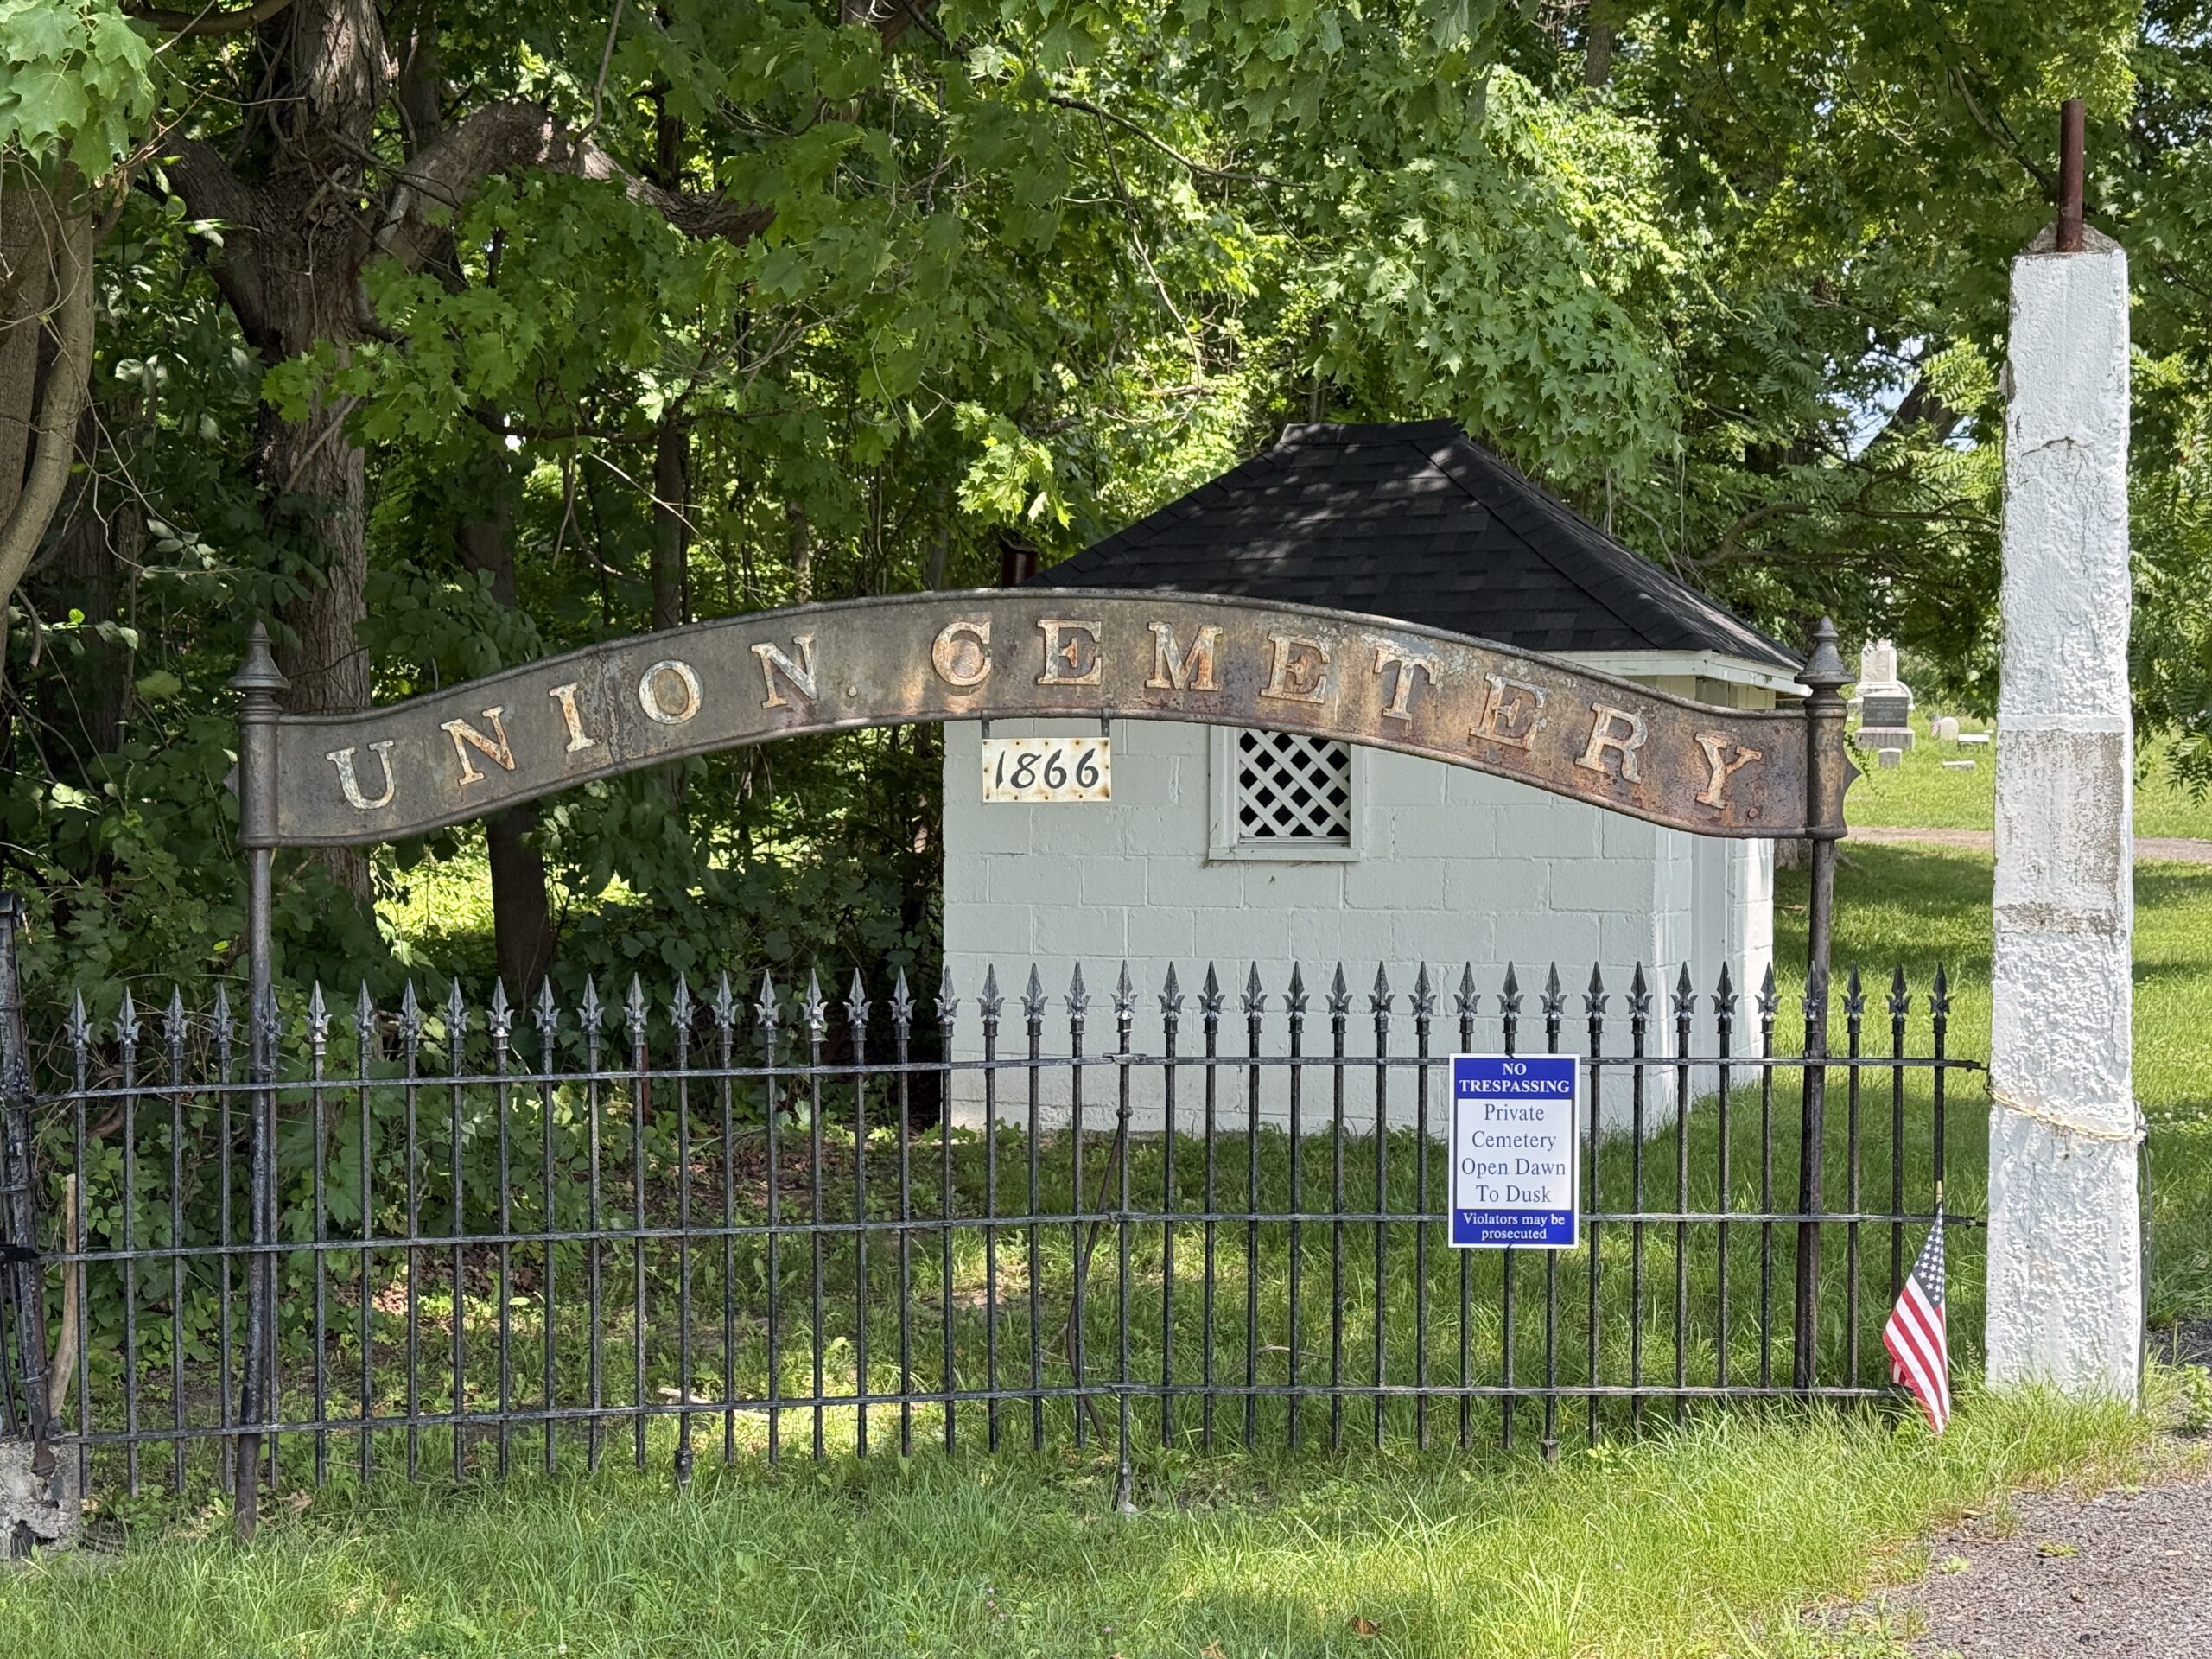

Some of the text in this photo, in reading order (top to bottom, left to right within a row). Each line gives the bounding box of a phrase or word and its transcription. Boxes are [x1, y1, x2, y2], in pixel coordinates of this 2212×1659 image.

[995, 747, 1099, 790] 1866
[1502, 1062, 1527, 1076] NO
[1459, 1080, 1570, 1093] TRESPASSING
[1484, 1103, 1545, 1121] Private
[1471, 1130, 1557, 1152] Cemetery
[1461, 1157, 1566, 1179] Open Dawn
[1476, 1185, 1552, 1203] To Dusk
[1463, 1212, 1566, 1227] Violators may be
[1481, 1228, 1548, 1241] prosecuted
